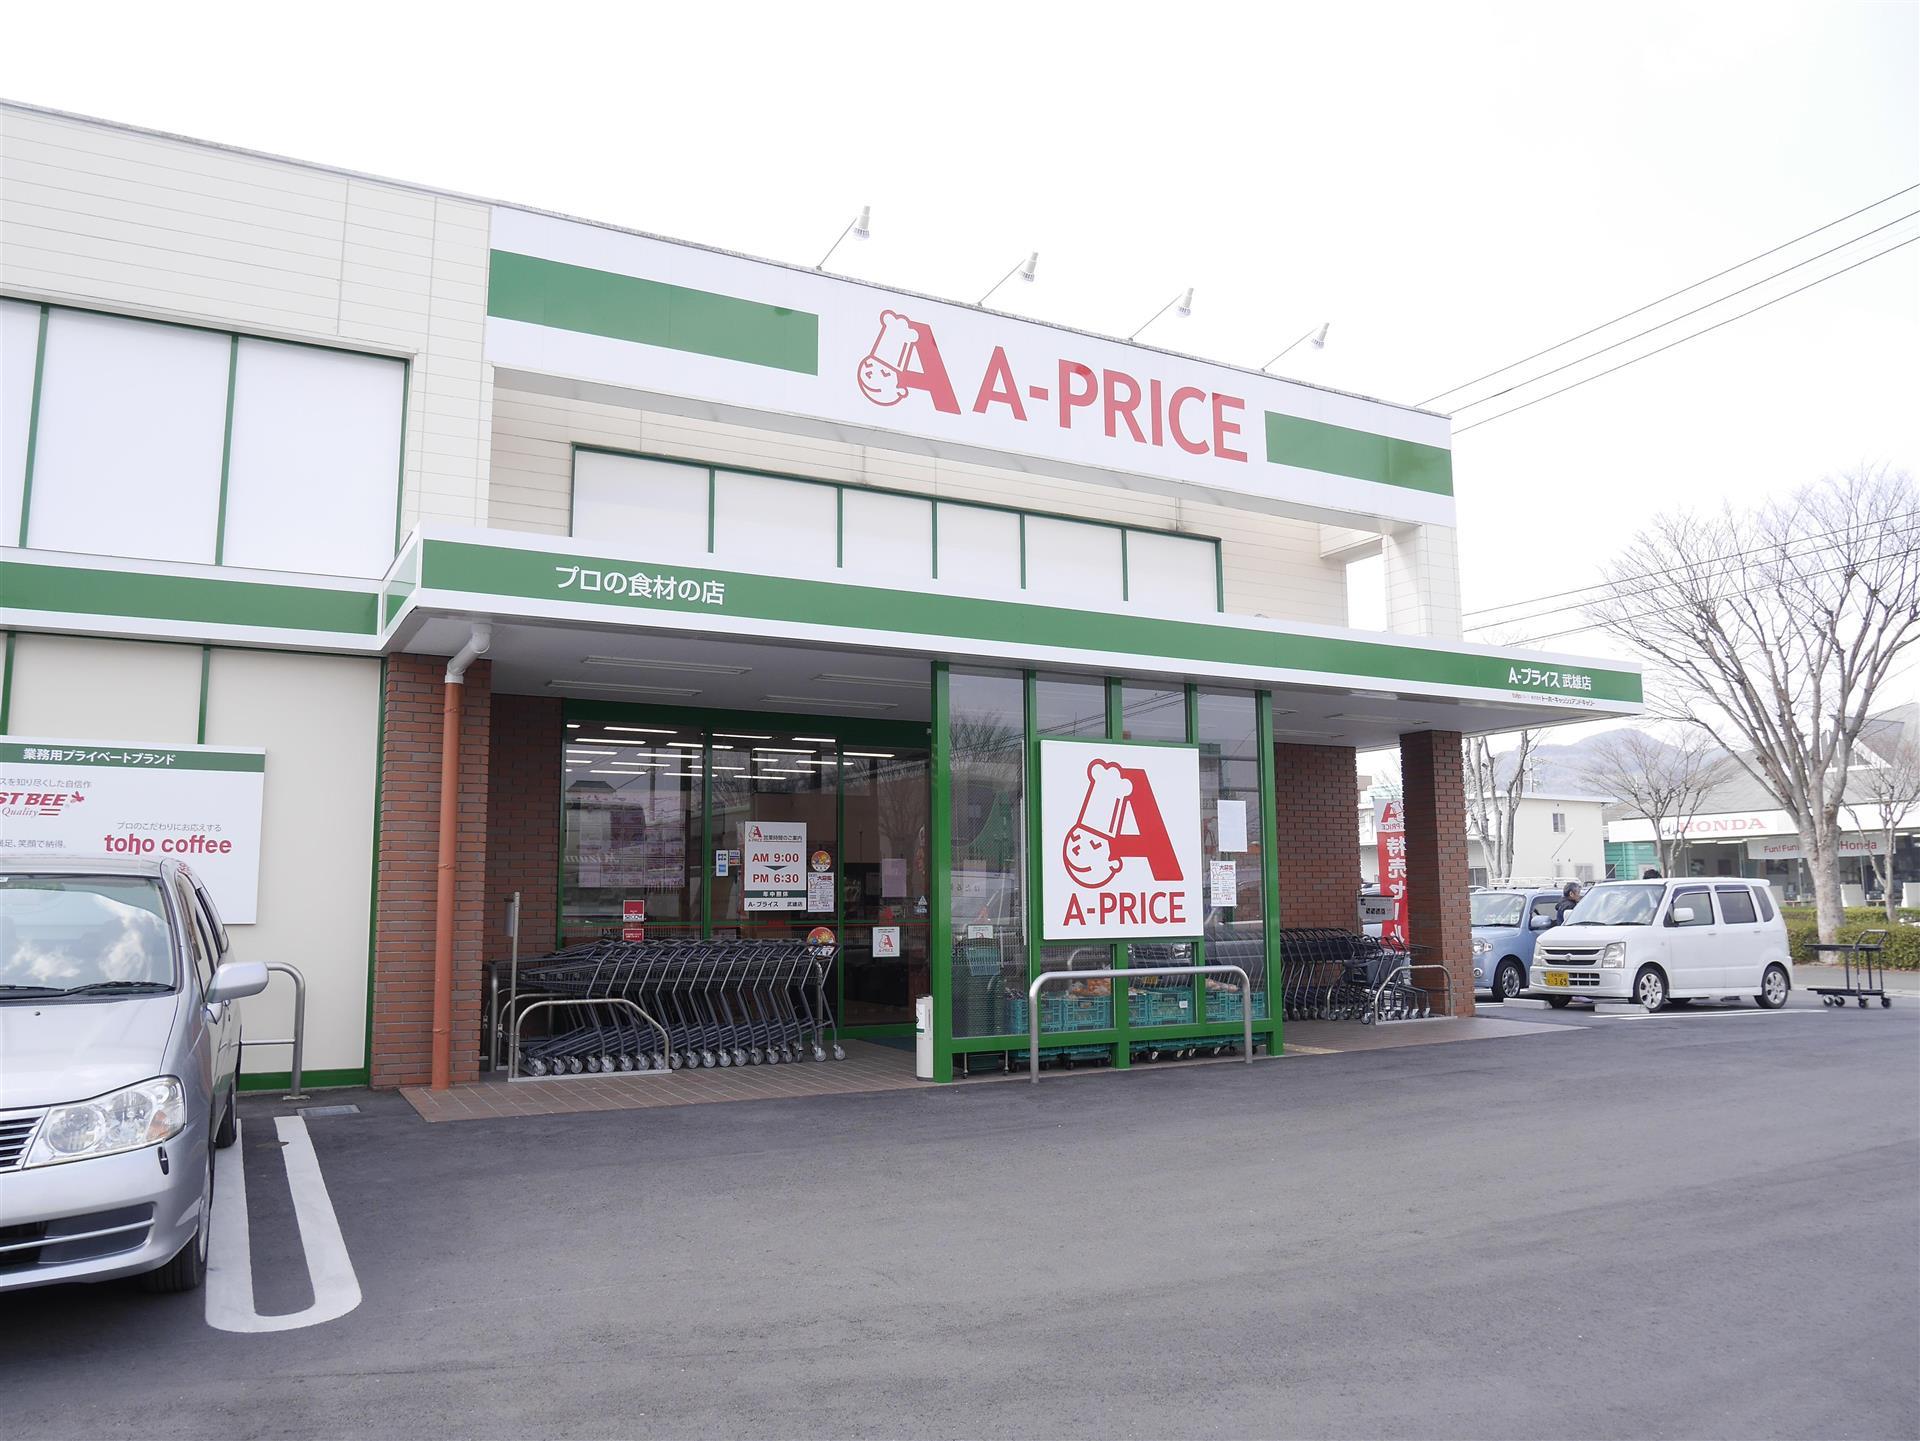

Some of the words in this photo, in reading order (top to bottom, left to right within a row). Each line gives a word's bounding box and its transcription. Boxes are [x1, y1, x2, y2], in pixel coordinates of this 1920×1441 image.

[972, 345, 1248, 463] A-PRICE
[555, 565, 725, 606] プロの食材の店
[23, 747, 176, 766] 業務用プライベートブランド
[24, 793, 68, 807] BEE
[2, 807, 39, 818] Quality
[117, 822, 222, 832] プロのこだわりにお応えする
[1680, 818, 1767, 833] HONDA
[104, 833, 155, 855] toho
[161, 834, 232, 854] coffee
[1840, 840, 1877, 851] Honda
[752, 853, 769, 863] AM
[774, 853, 799, 863] 9:00
[752, 873, 769, 883] PM
[774, 873, 799, 883] 6:30
[1062, 892, 1186, 927] A-PRICE
